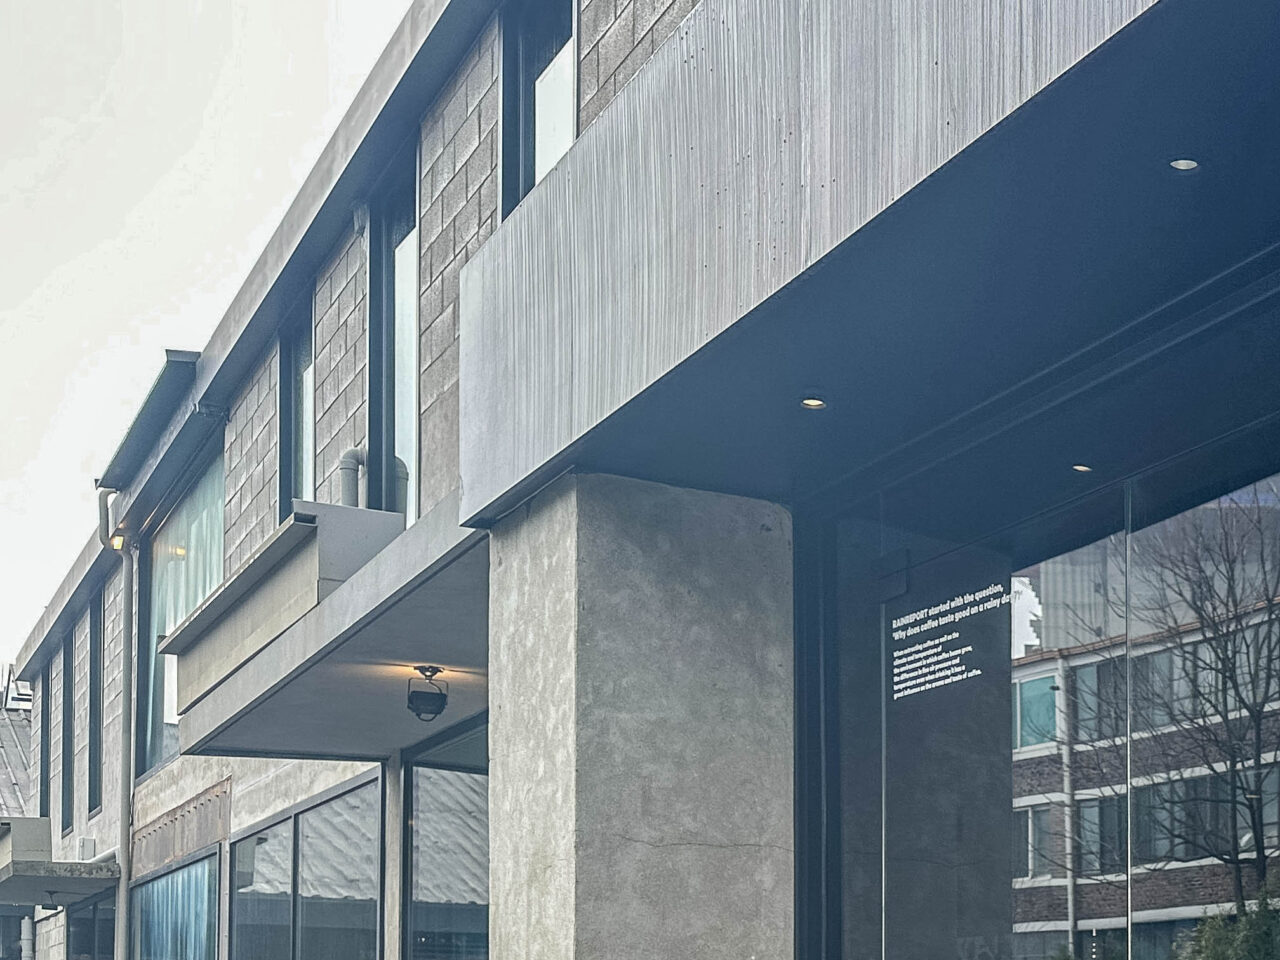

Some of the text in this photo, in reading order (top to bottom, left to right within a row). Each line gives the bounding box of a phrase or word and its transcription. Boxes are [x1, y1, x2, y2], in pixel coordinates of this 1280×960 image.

[906, 624, 920, 637] does
[920, 618, 939, 632] coffee
[939, 612, 955, 625] taste
[954, 606, 971, 622] good
[971, 604, 979, 614] on
[979, 603, 984, 612] a
[984, 597, 1001, 610] rainy
[928, 600, 950, 616] started
[950, 595, 964, 609] with
[964, 593, 975, 604] the
